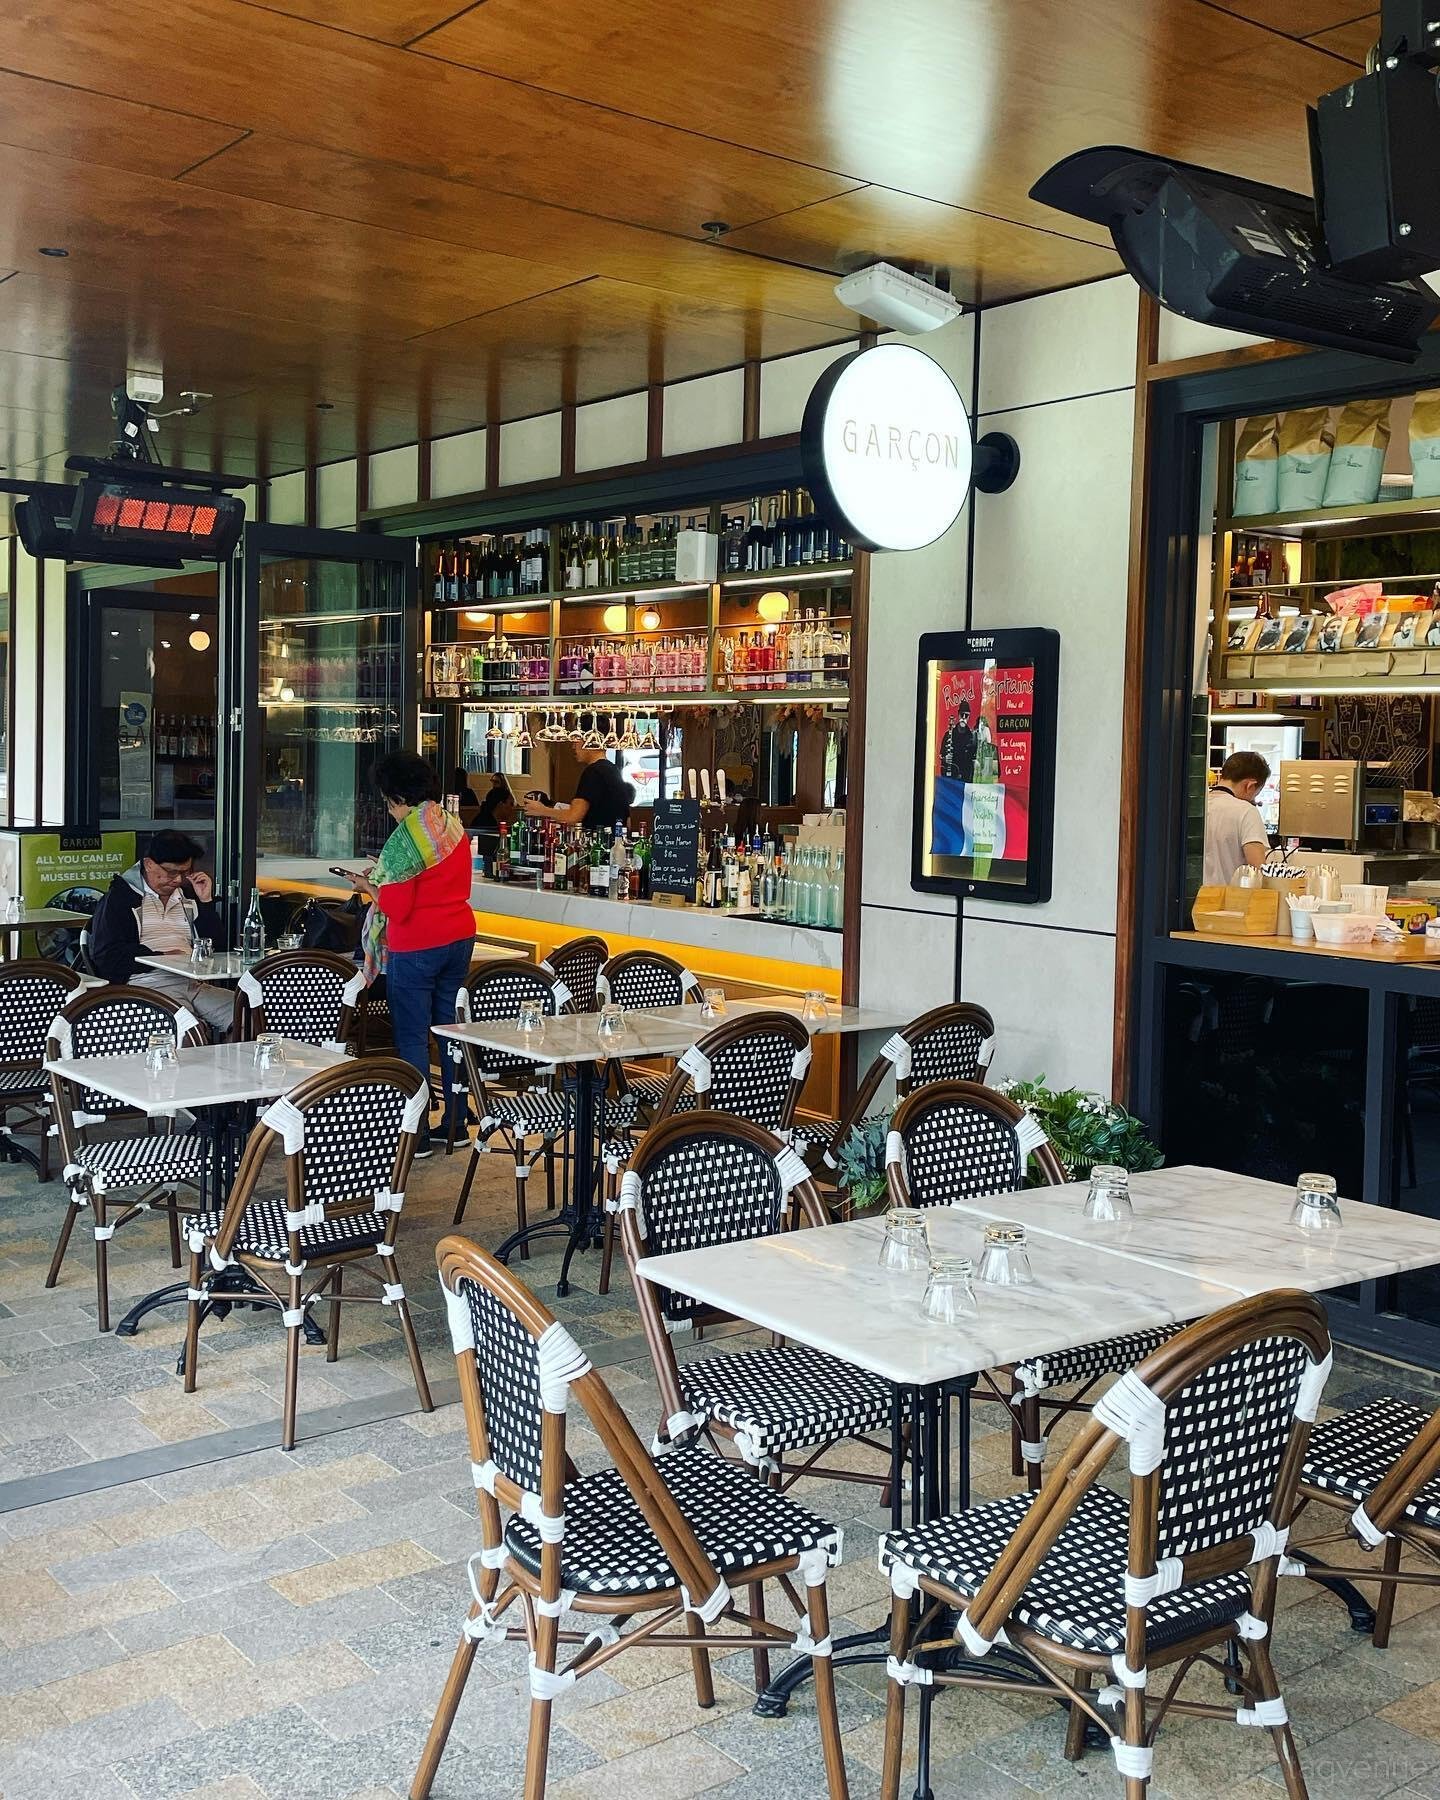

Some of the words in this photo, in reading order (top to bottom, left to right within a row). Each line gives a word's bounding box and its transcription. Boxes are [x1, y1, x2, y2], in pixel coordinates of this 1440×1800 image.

[842, 419, 960, 472] GARÇON
[971, 637, 995, 648] CANOPY
[942, 675, 976, 711] Road
[999, 718, 1030, 730] GARÇON
[62, 837, 100, 849] GARÇON
[36, 855, 55, 865] ALL
[57, 854, 80, 864] YOU
[82, 854, 103, 863] CAN
[106, 853, 124, 862] EAT
[40, 872, 87, 882] MUSSELS
